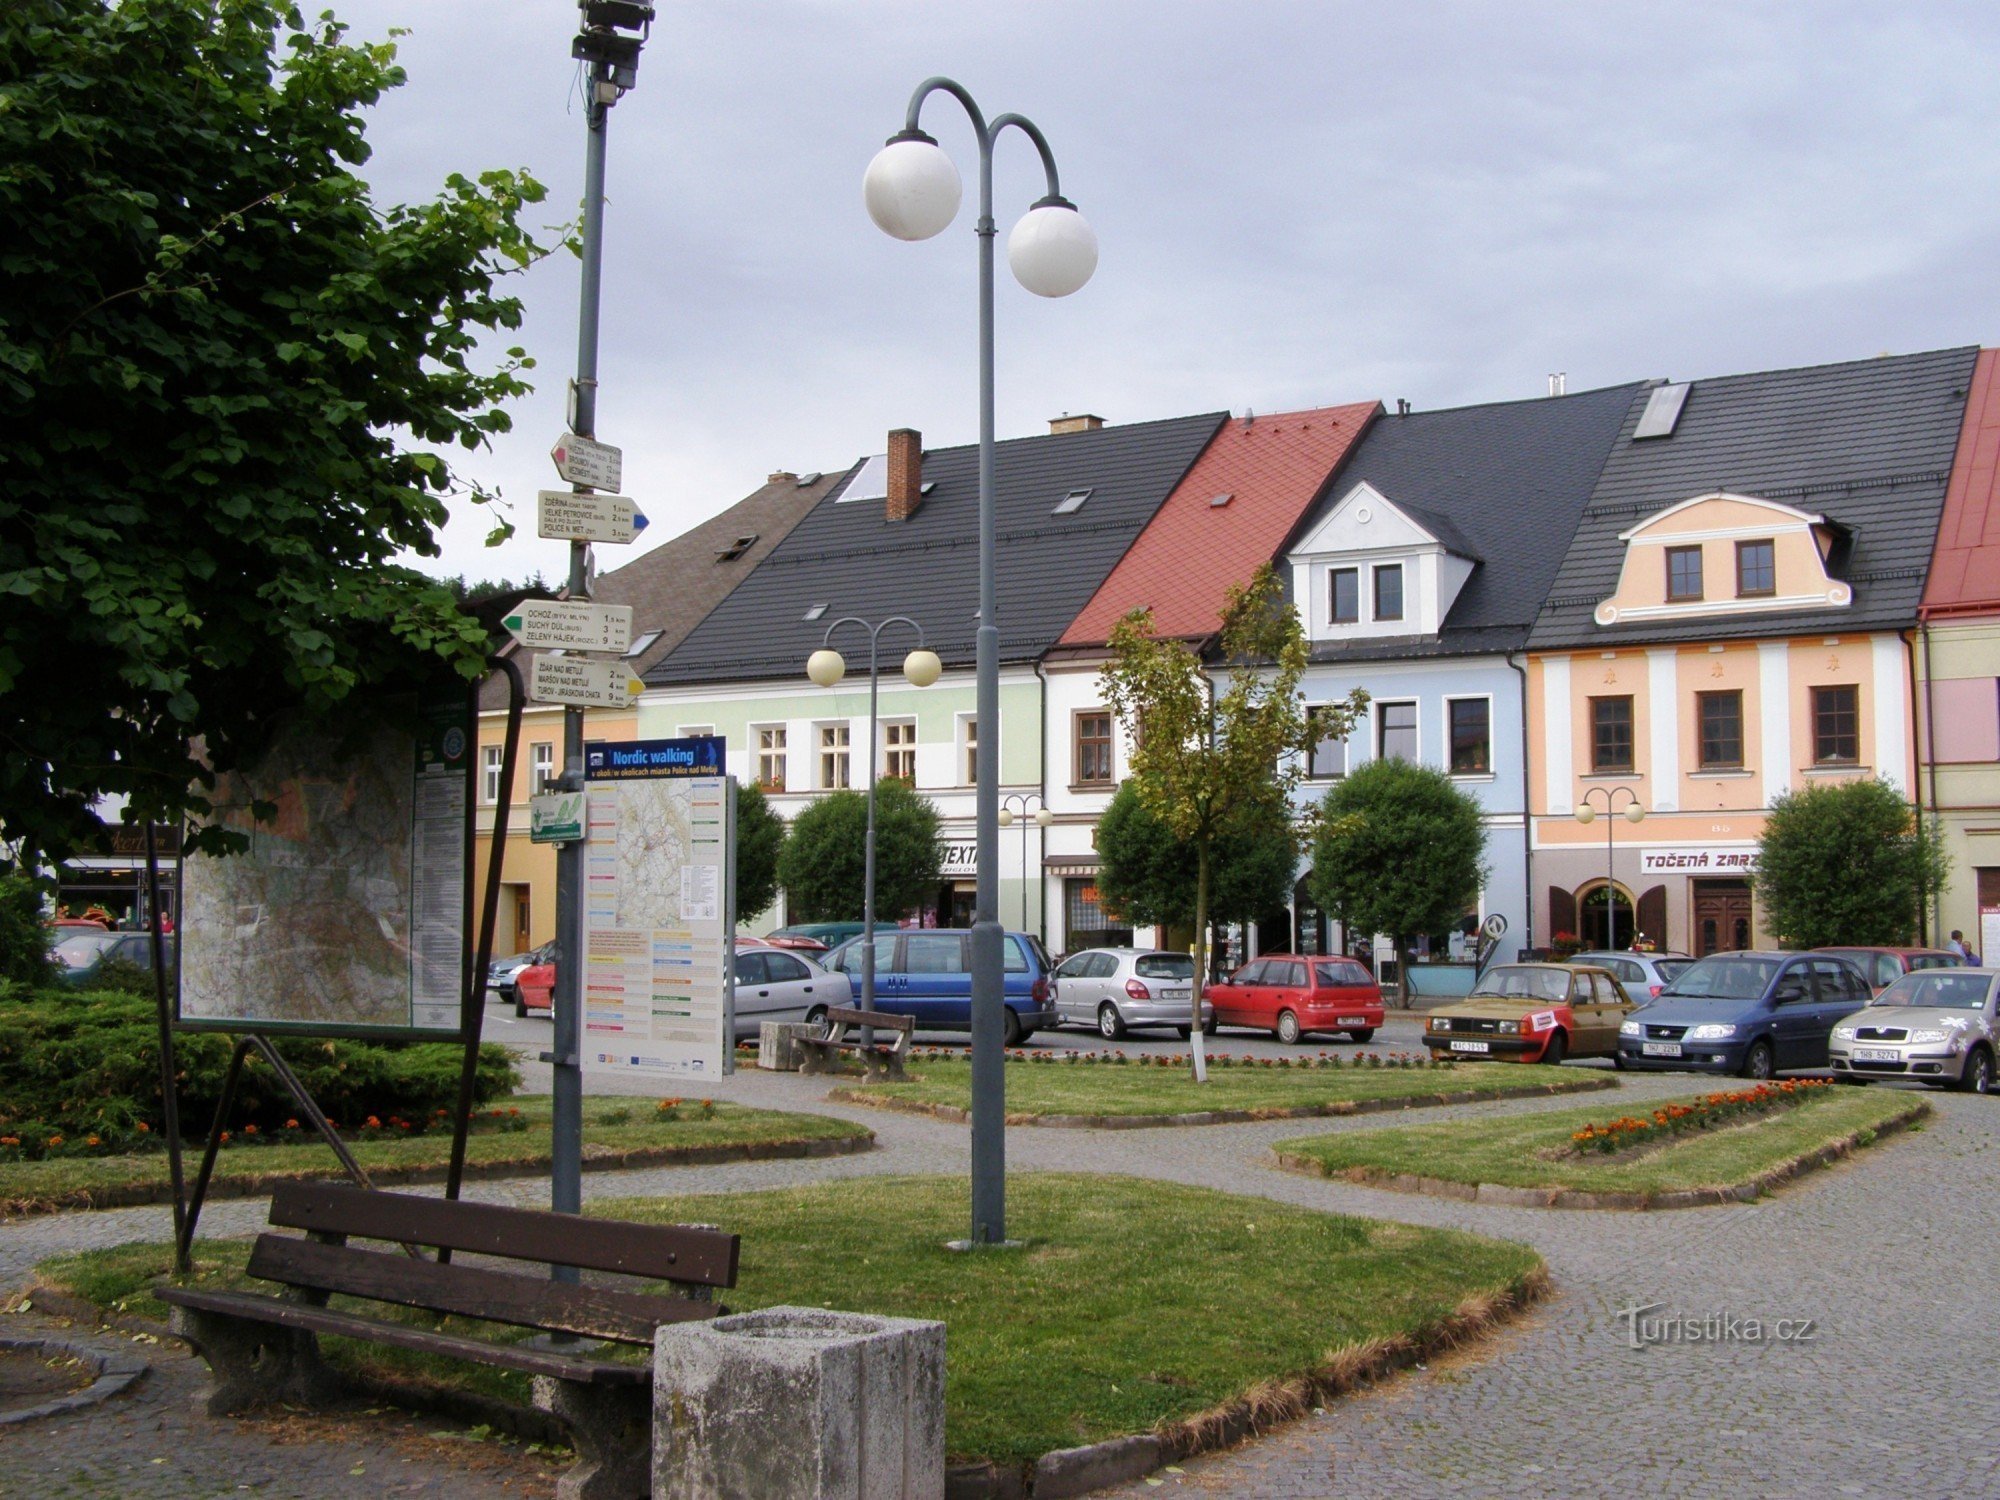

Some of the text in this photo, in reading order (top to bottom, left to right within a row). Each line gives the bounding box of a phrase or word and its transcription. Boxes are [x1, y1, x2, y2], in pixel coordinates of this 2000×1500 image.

[563, 510, 592, 520] PETROVICE
[544, 524, 564, 532] POLICE
[604, 626, 608, 634] 3
[602, 636, 608, 644] 9
[554, 665, 565, 673] NAD
[560, 677, 570, 686] NAD
[609, 681, 614, 689] 4
[586, 690, 600, 698] CHATA
[613, 750, 648, 765] Nordic
[650, 748, 694, 766] walking
[621, 767, 648, 777] okolicach
[650, 767, 670, 776] miasta
[1646, 852, 1709, 868] TOČENÁ
[1877, 1051, 1895, 1060] 5274
